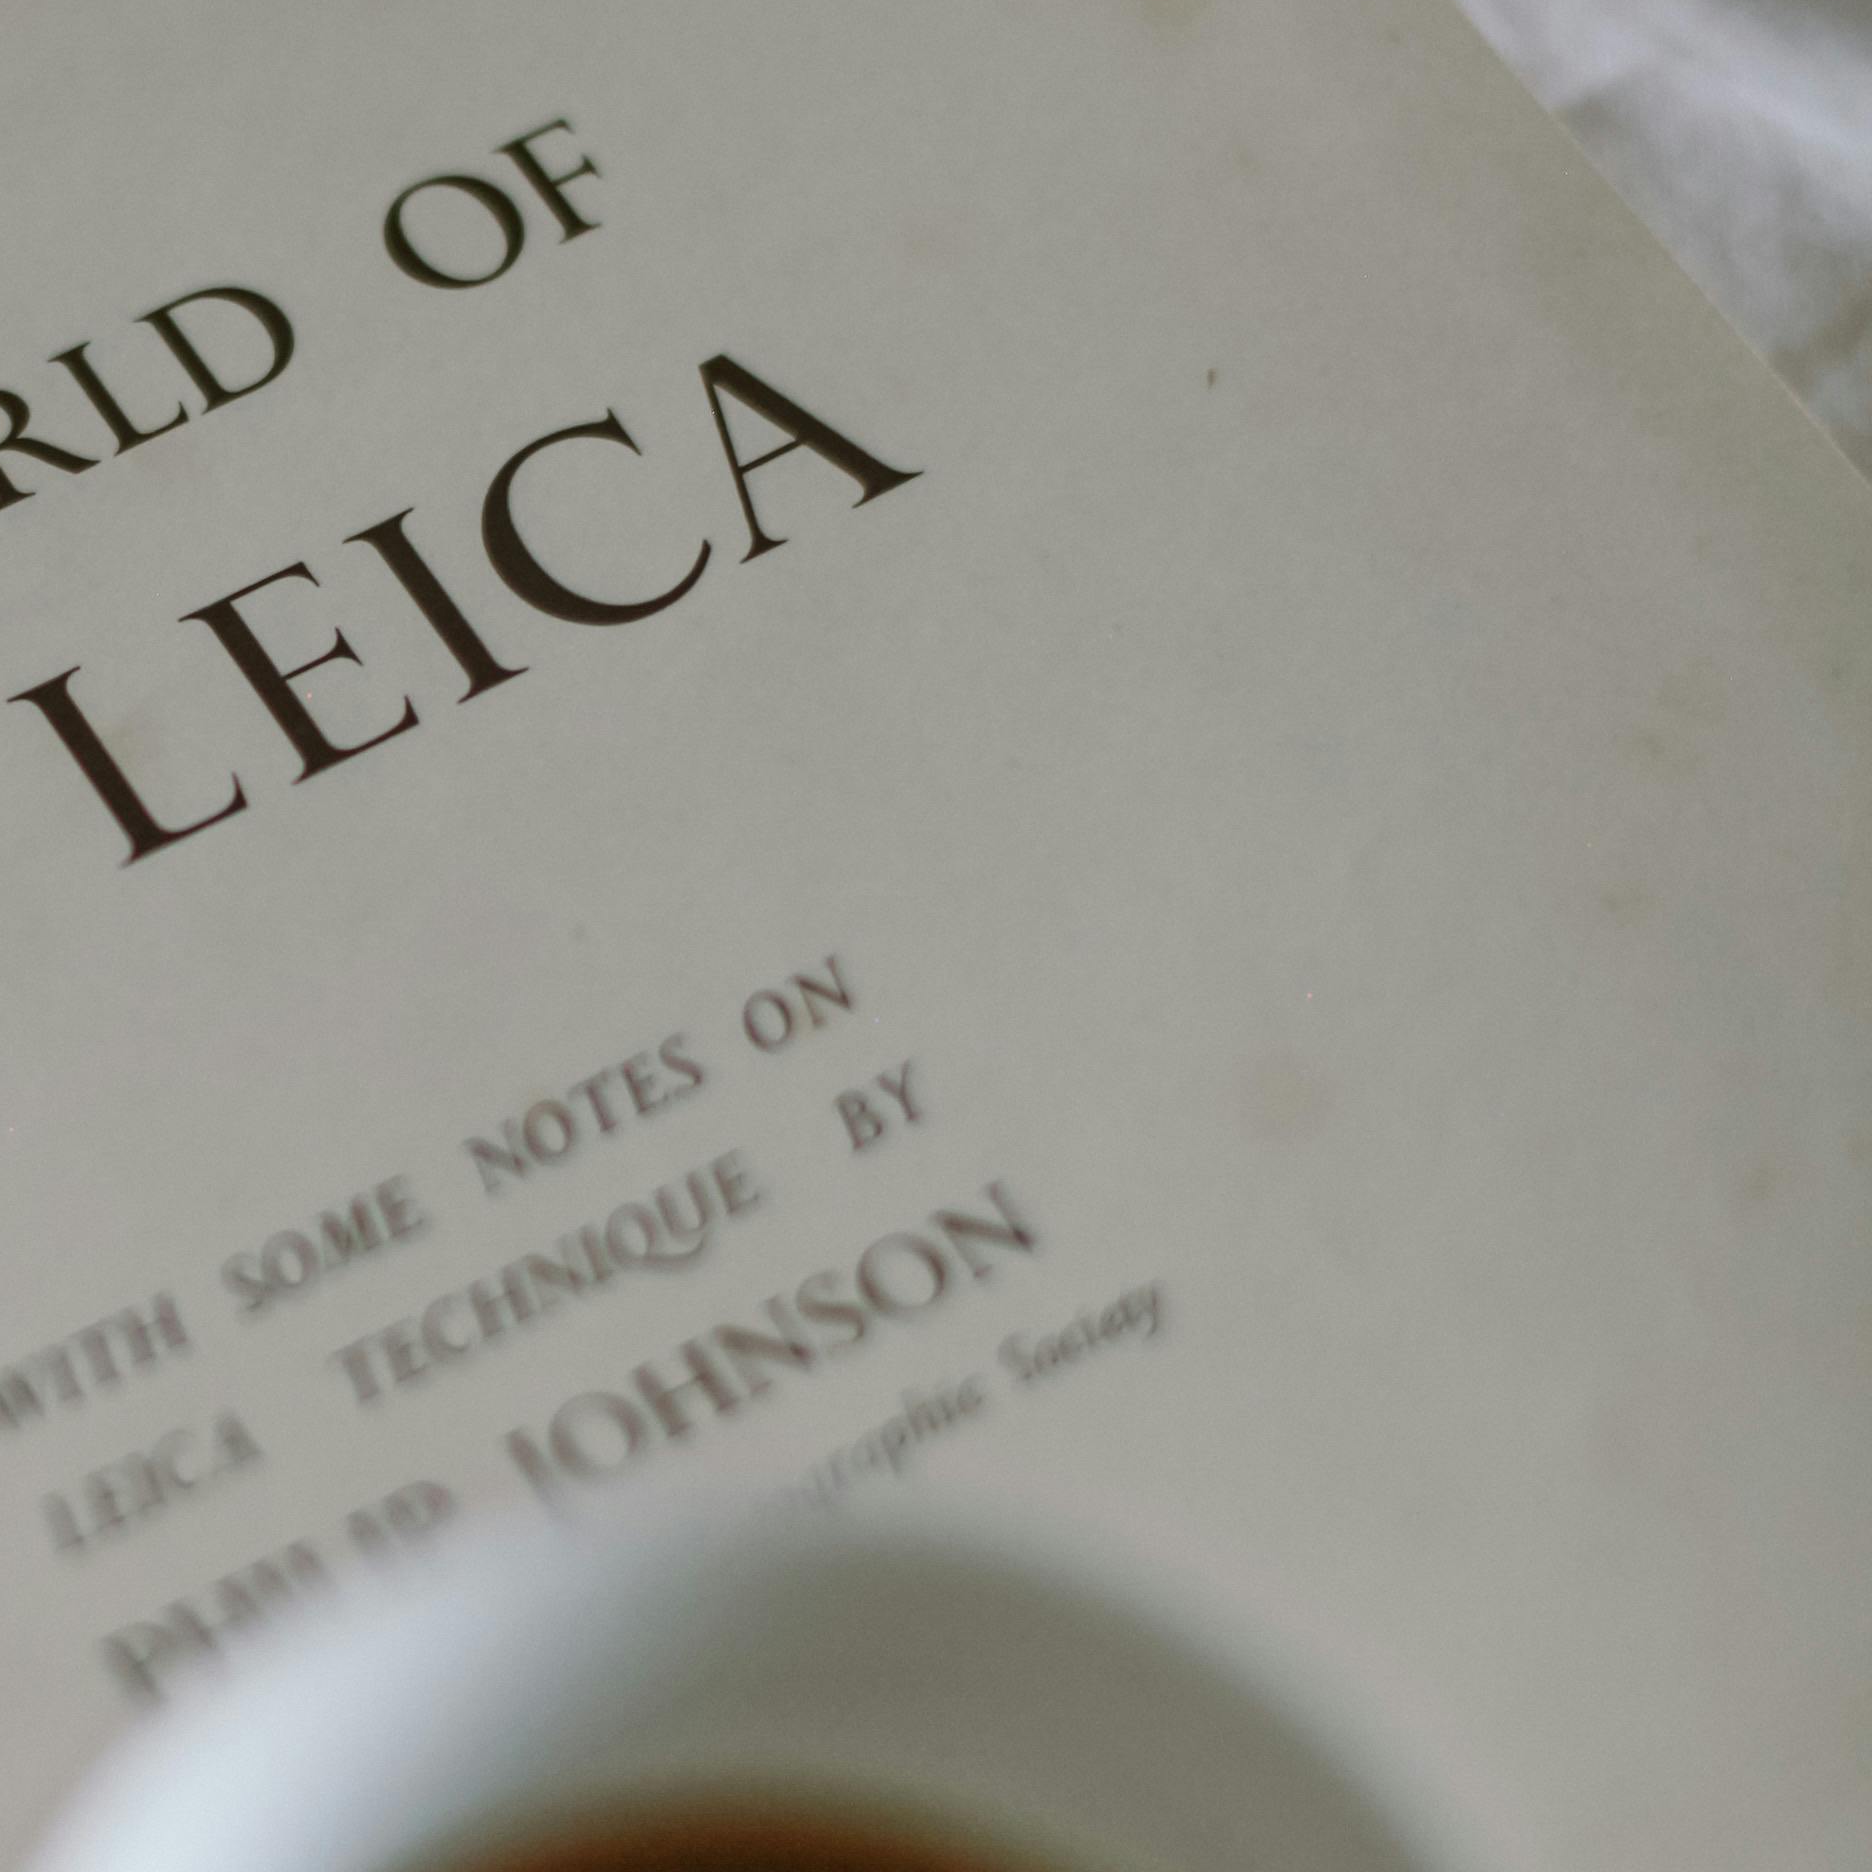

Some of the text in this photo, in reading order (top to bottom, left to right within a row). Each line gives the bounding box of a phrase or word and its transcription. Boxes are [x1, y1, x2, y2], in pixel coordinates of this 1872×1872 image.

[382, 117, 603, 290] OF
[6, 352, 924, 867] LEICA
[222, 1177, 427, 1317] SOME
[464, 1033, 707, 1194] NOTES
[742, 954, 856, 1054] ON
[46, 1060, 926, 1556] LEICA TECHNIQUE BY
[505, 1181, 1040, 1505] JOHNSON
[998, 1282, 1169, 1389] Society
